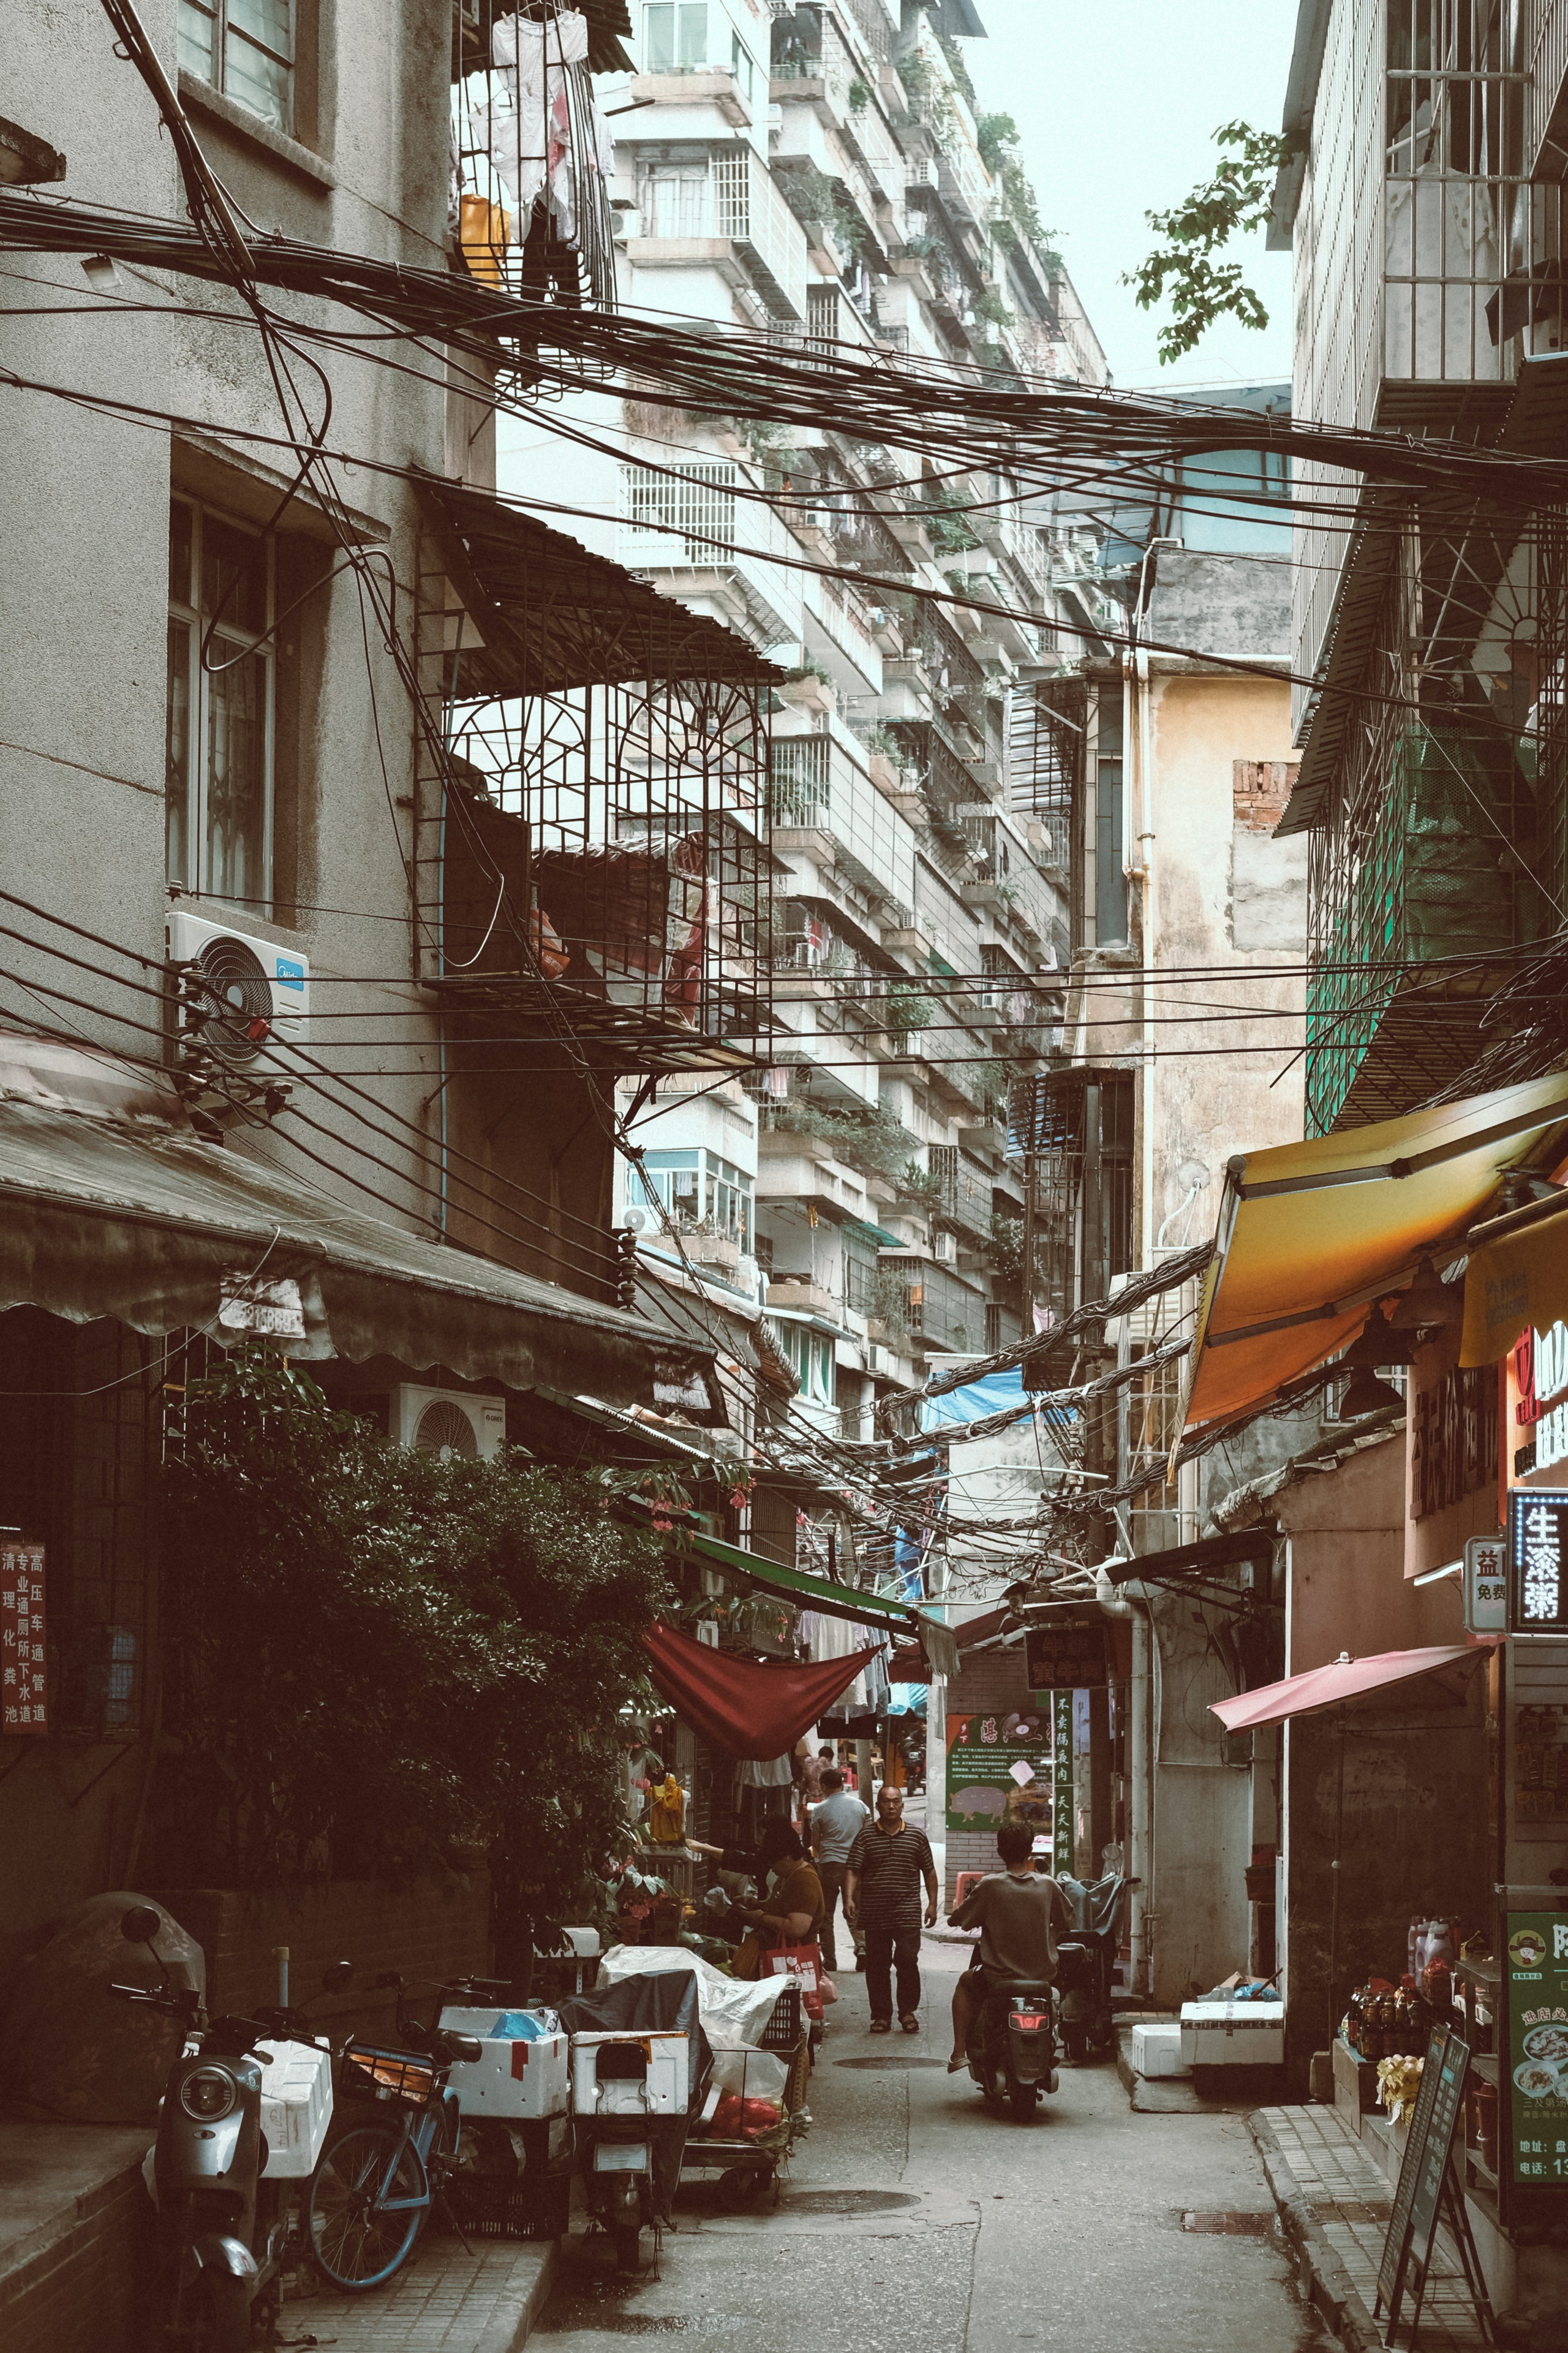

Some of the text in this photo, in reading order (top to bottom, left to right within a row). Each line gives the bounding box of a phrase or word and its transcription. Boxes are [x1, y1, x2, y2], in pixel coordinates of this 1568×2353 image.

[2, 1552, 18, 1723] 清理化粪池
[17, 1552, 32, 1723] 专业通厕所下水道
[31, 1554, 46, 1722] 高压车通管道
[1056, 1698, 1070, 1862] 不卖隔夜肉 天天新鲜
[1521, 2007, 1568, 2025] 进店必
